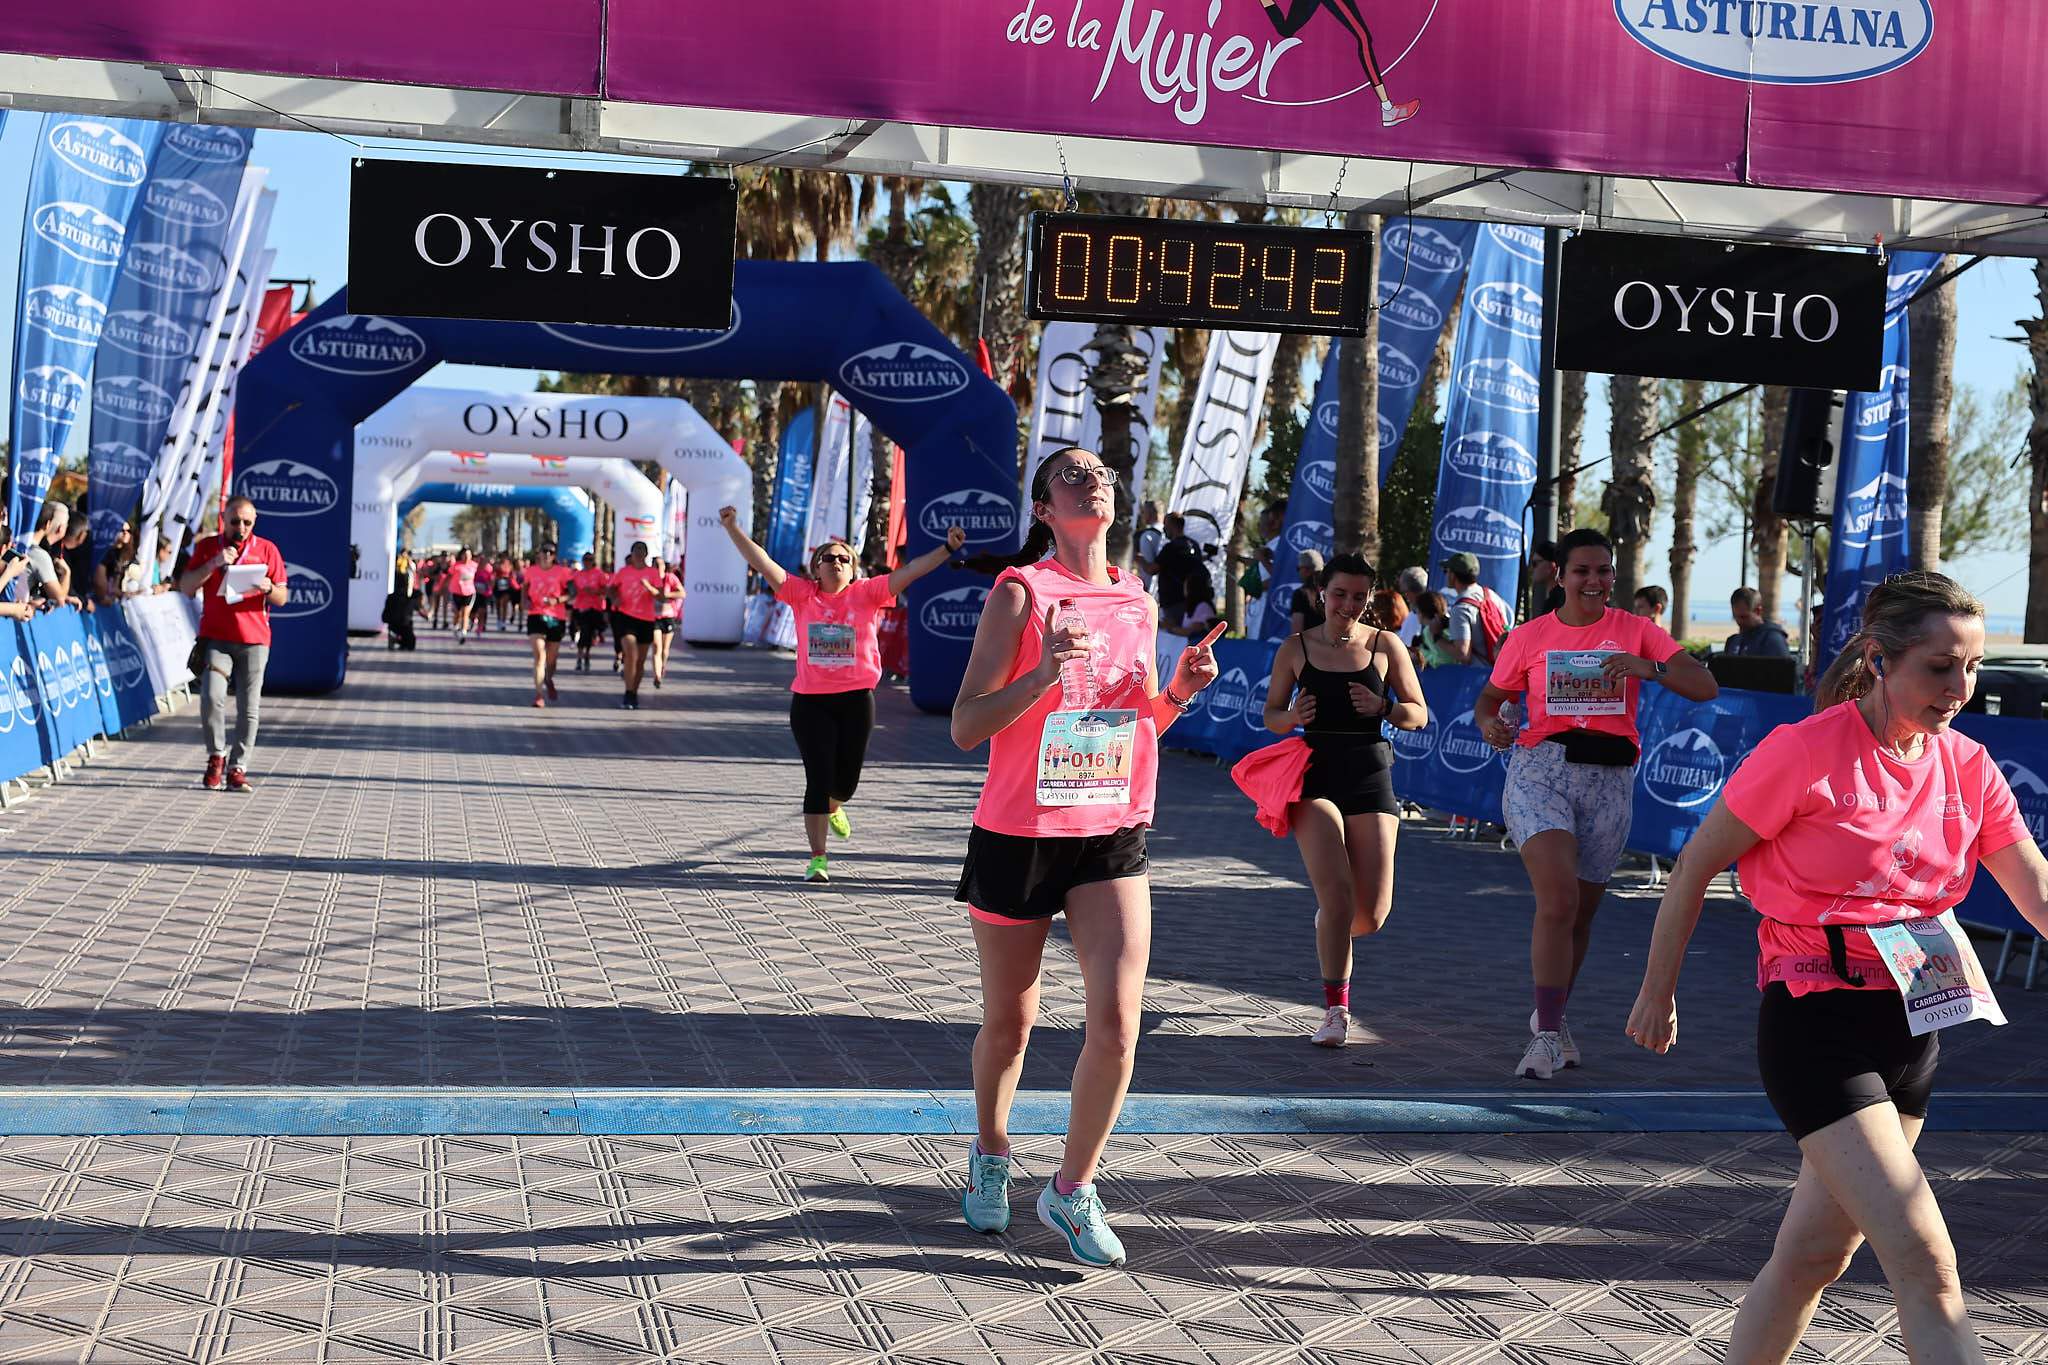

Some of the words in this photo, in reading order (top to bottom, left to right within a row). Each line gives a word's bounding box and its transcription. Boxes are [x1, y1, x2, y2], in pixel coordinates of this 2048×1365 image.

[1639, 0, 1908, 49] ASTURIANA
[1006, 0, 1056, 44] de
[1066, 0, 1101, 50] la
[1091, 0, 1303, 125] Mujer
[414, 213, 681, 280] OYSHO
[1055, 232, 1345, 315] 00:42:42
[1613, 280, 1839, 343] OYSHO
[106, 319, 186, 352] ASTURIANA
[299, 333, 414, 361] ASTURIANA
[851, 364, 960, 387] ASTURIANA
[463, 403, 629, 441] OYSHO
[360, 435, 413, 450] OYSHO
[674, 447, 725, 460] OYSHO
[241, 479, 331, 505] ASTURIANA
[697, 515, 743, 528] OYSO
[927, 510, 1013, 530] ASTURIANA
[1441, 524, 1520, 552] ASTURIANA
[693, 581, 740, 594] OYSHO
[927, 606, 980, 627] ASTUR
[1648, 753, 1716, 790] ASTURIANA
[1843, 792, 1897, 812] OYSHO
[1914, 994, 1947, 1009] CARRERA
[1948, 990, 1958, 999] DE
[1924, 1002, 1969, 1024] OYSHO
